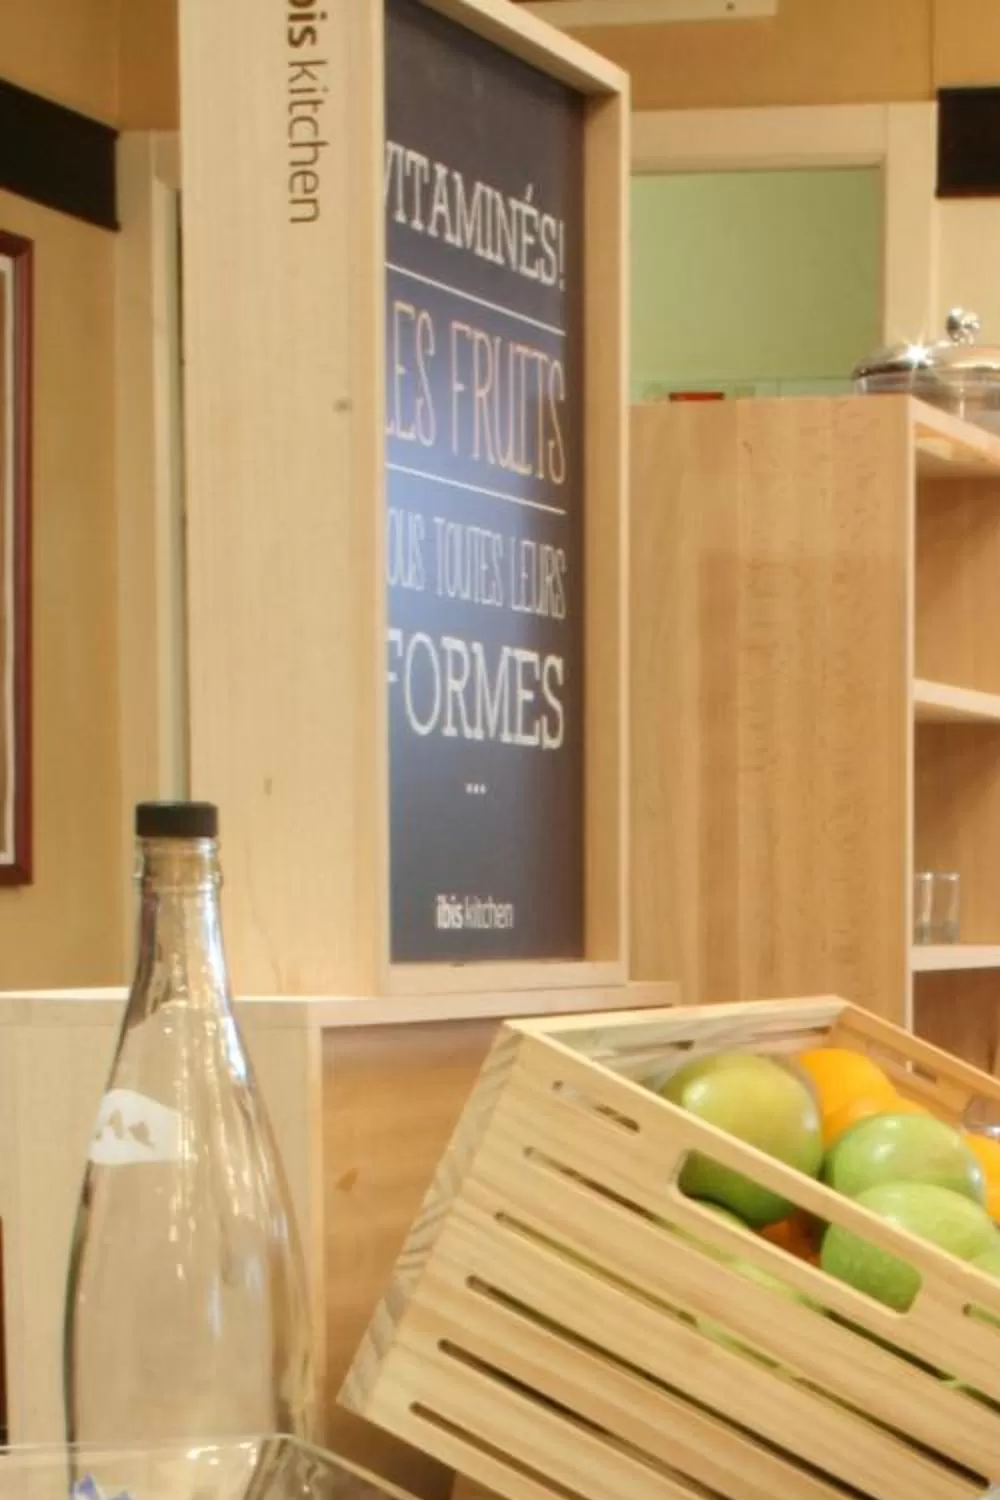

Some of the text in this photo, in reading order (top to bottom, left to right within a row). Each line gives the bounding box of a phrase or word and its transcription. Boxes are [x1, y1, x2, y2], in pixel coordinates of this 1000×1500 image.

[288, 59, 329, 224] kitchen
[450, 320, 566, 486] FRUITS
[386, 507, 568, 621] OUS TOUTES LEURS
